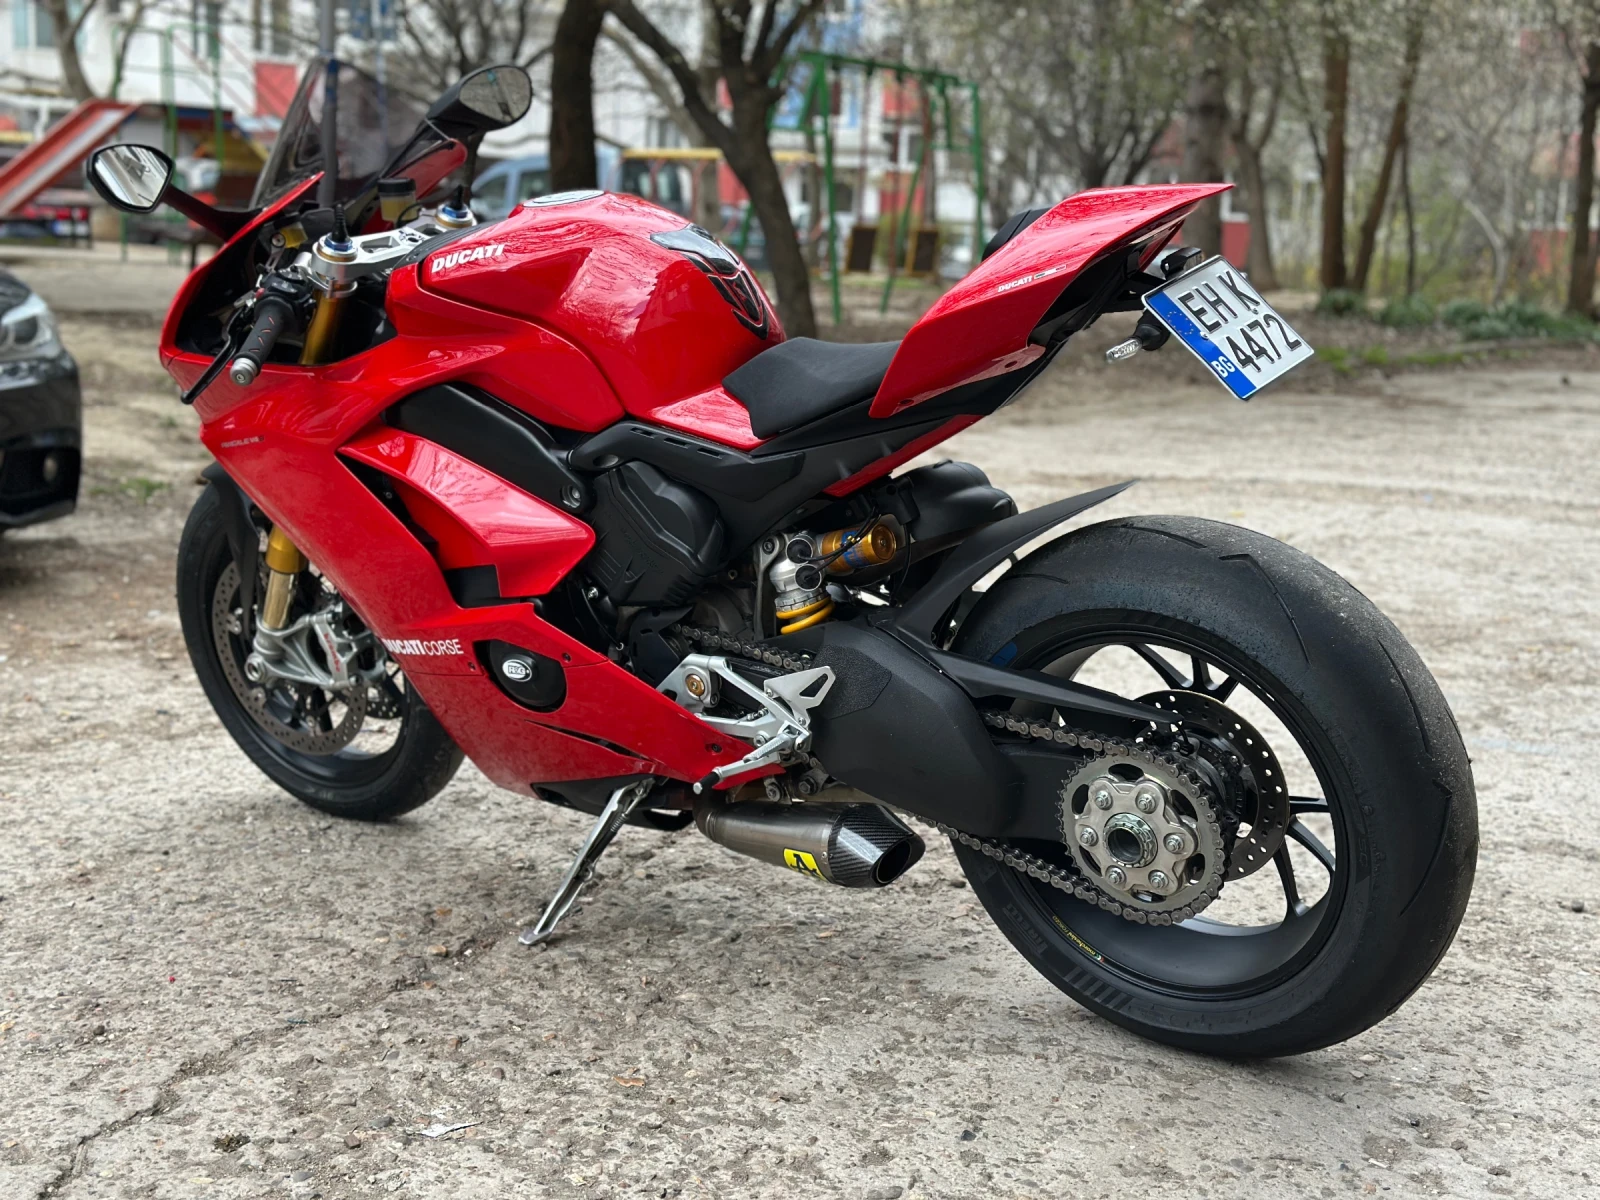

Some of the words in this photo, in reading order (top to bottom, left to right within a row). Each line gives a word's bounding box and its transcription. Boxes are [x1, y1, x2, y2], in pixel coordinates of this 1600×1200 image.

[431, 244, 505, 273] DUCATI
[997, 275, 1032, 292] DUCATI
[1178, 281, 1238, 334] EH
[1216, 270, 1261, 311] K
[1226, 313, 1302, 373] 4472
[1211, 355, 1236, 378] BG
